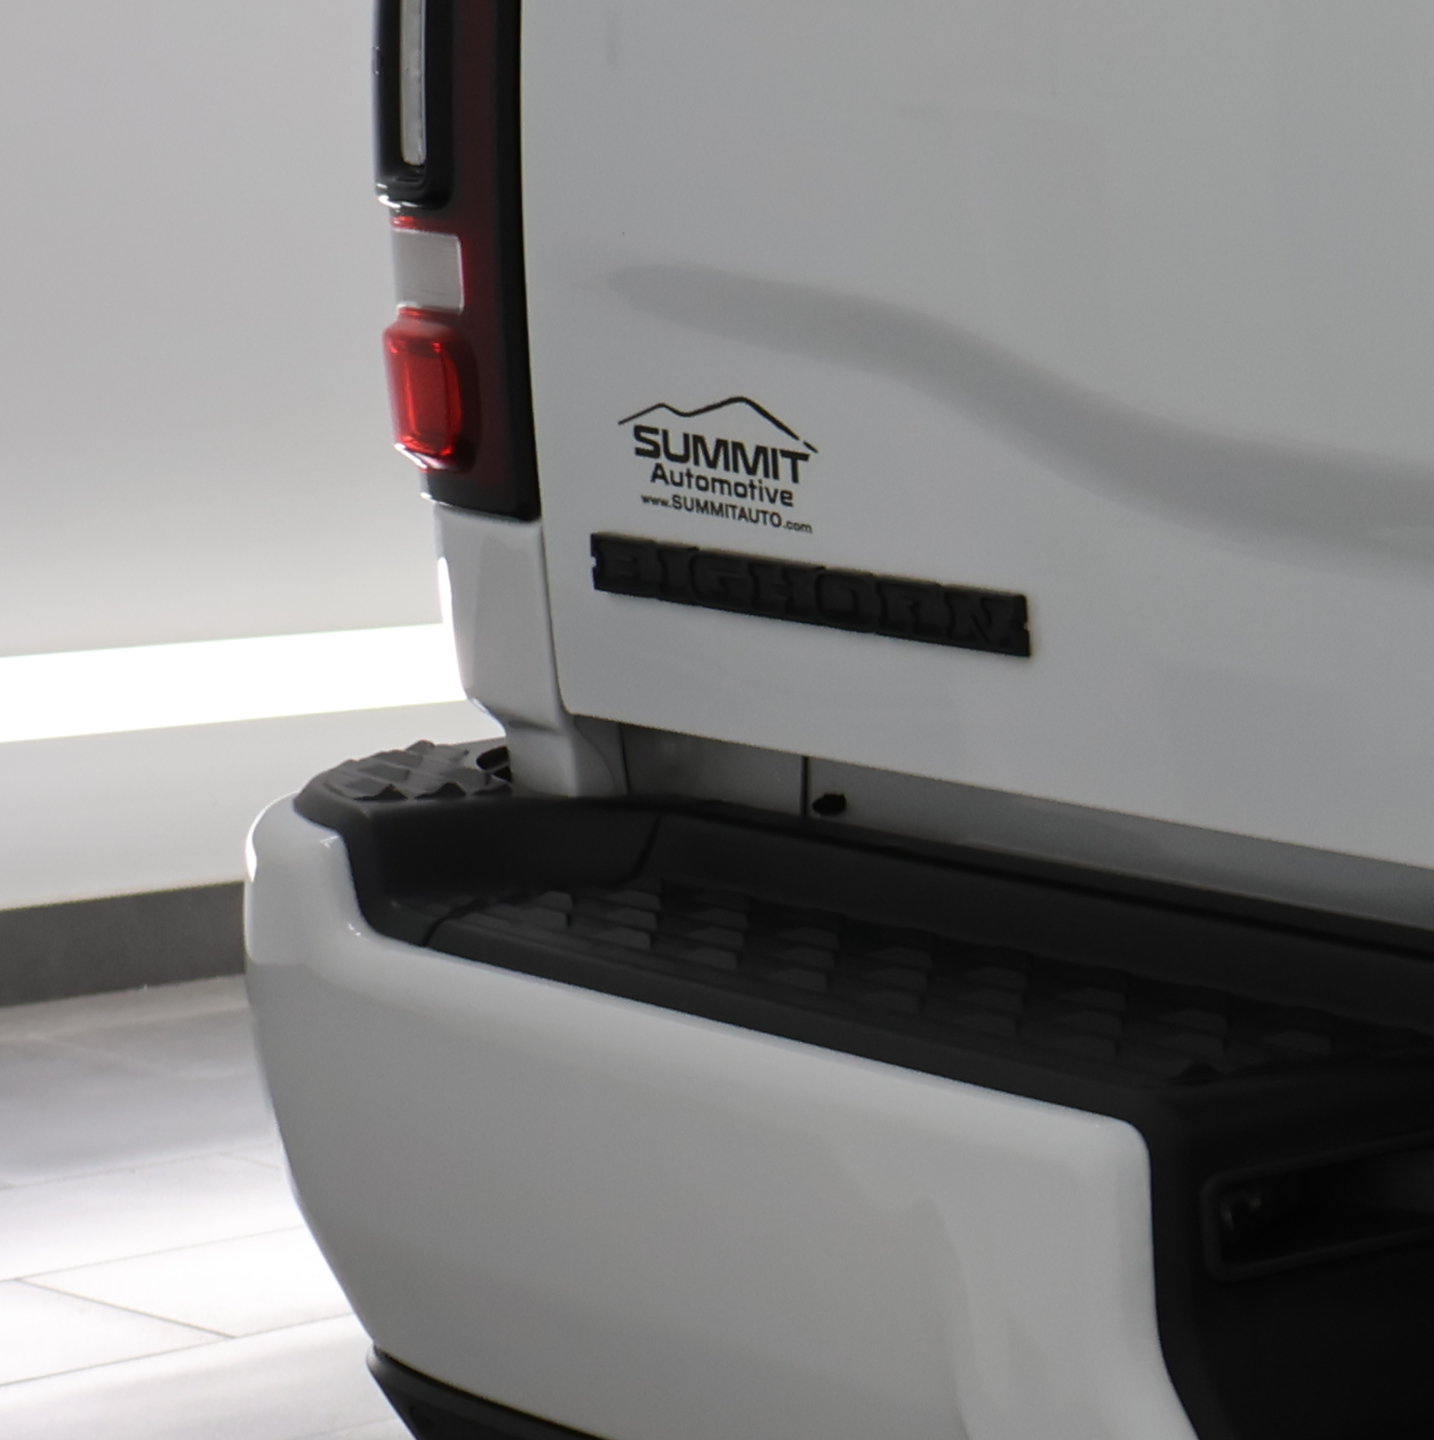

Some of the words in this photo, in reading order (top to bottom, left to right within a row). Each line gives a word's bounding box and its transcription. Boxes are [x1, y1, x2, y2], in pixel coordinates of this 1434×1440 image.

[633, 424, 810, 484] SUMMIT
[650, 463, 794, 507] Automotive
[641, 494, 813, 534] www.SUMMITAUTO.com
